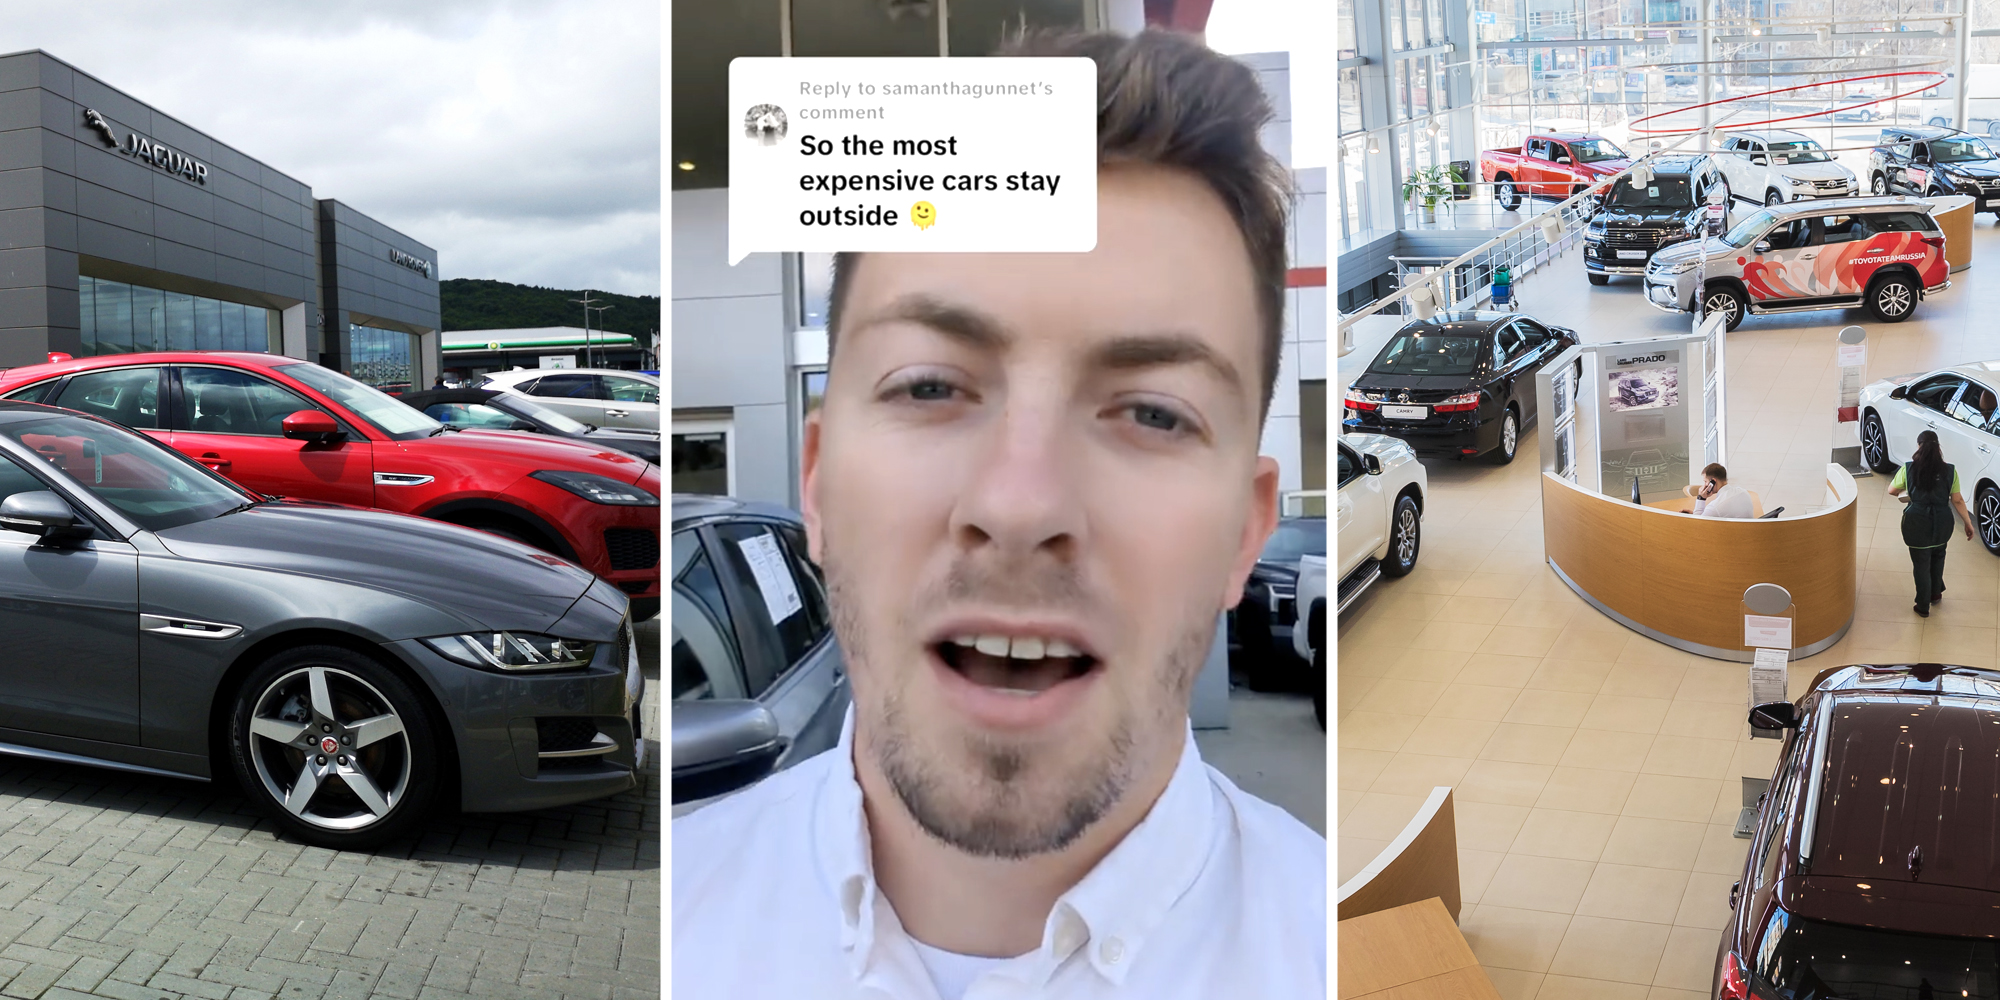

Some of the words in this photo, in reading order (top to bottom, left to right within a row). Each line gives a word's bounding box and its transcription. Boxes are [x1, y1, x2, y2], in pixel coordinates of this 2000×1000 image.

[120, 133, 208, 183] JAGUAR
[1848, 252, 1926, 265] #TOYOTATEAMRUSSIA
[1632, 354, 1666, 364] PRADO
